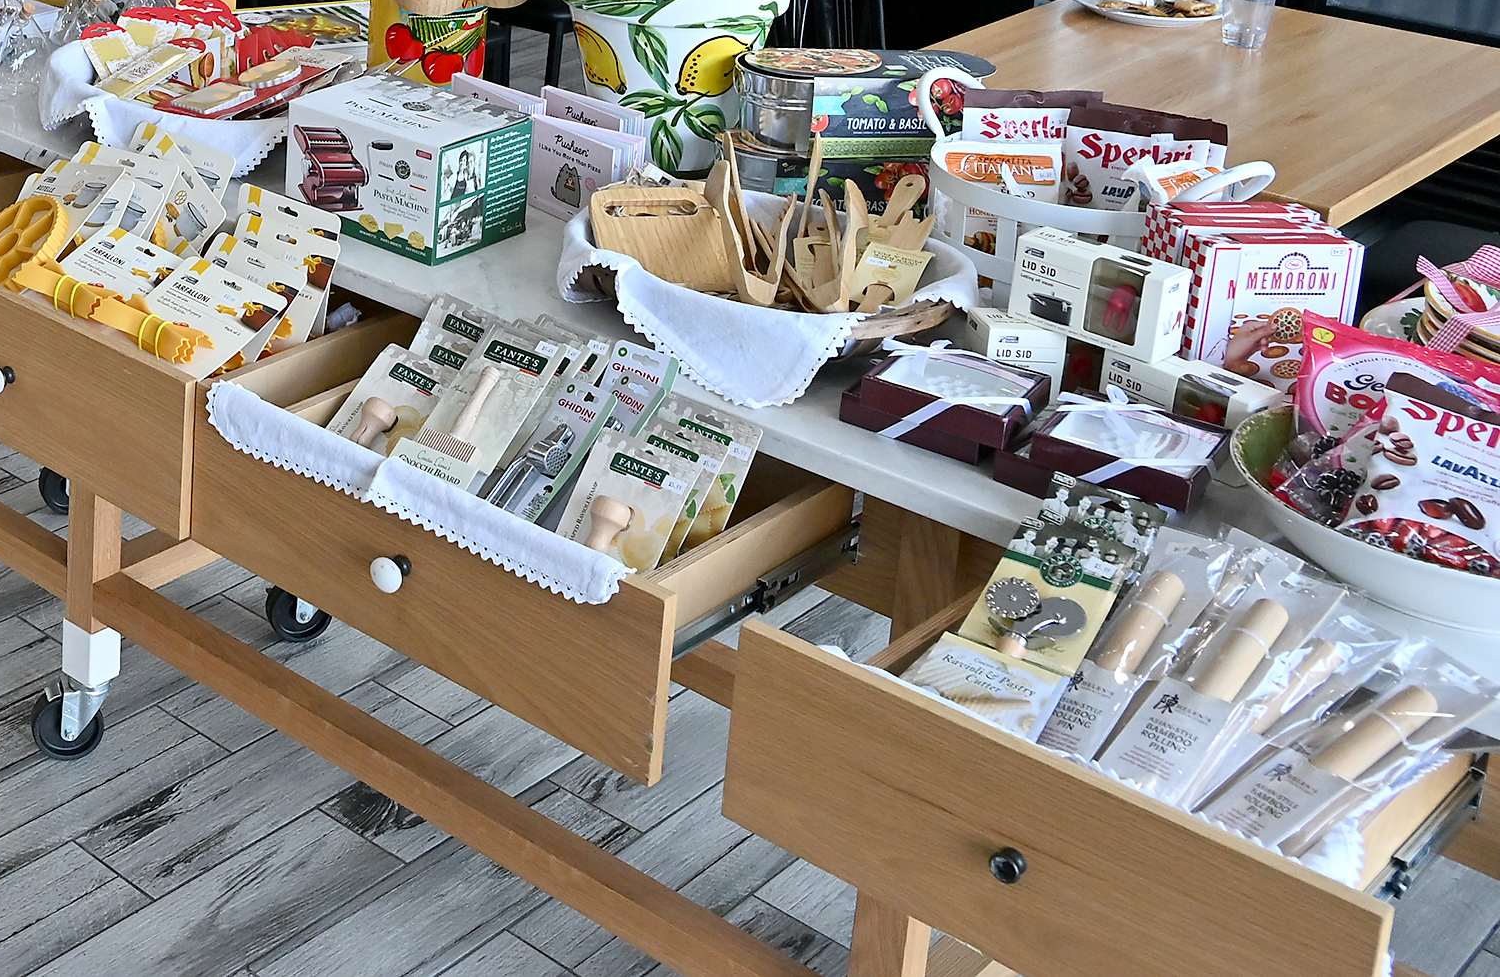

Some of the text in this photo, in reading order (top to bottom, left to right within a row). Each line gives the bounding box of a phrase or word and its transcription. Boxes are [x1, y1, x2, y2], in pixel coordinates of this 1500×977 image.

[565, 105, 597, 126] Pusheen
[847, 117, 928, 130] TOMATO & BASIL
[554, 134, 590, 157] Pusheen
[1077, 133, 1194, 169] Sperlari
[542, 144, 552, 153] Like
[552, 148, 562, 158] You
[562, 153, 575, 162] More
[575, 158, 587, 168] than
[587, 163, 602, 174] Pizza
[373, 189, 394, 203] PASTA
[394, 197, 430, 215] MACHINE
[89, 246, 126, 266] FARFALLONI
[1022, 259, 1057, 277] LID SID
[1245, 272, 1337, 291] MEMORONI
[172, 282, 210, 303] FARFALLONI
[437, 350, 464, 365] FANT
[494, 345, 540, 367] FANTE'S
[996, 348, 1032, 359] LID SID
[397, 367, 433, 389] FANTE'S
[1108, 371, 1142, 392] LID SID
[558, 398, 596, 420] GHIDINI
[612, 390, 645, 412] GHIDINI
[628, 407, 640, 416] ITALY
[579, 415, 592, 424] ITALY
[1400, 399, 1500, 449] Sper
[685, 424, 726, 445] FANTE'S
[652, 440, 692, 460] FANTE'S
[399, 453, 461, 486] GNOCCHI BOARD
[619, 457, 662, 481] FANTE'S
[1431, 455, 1500, 488] LAVAZZ
[576, 481, 599, 525] RAVIOLI STAMP
[942, 654, 1036, 698] Ravioli & Pastry
[965, 674, 1002, 693] Cutter
[1060, 697, 1102, 715] SIAN-STYLE
[1056, 719, 1075, 731] PIN
[1145, 722, 1192, 747] BAMBOO
[1149, 717, 1199, 742] ASIAN-STYLE
[1140, 729, 1187, 754] ROLLING
[1148, 741, 1168, 754] PIN
[1246, 806, 1265, 818] PIN
